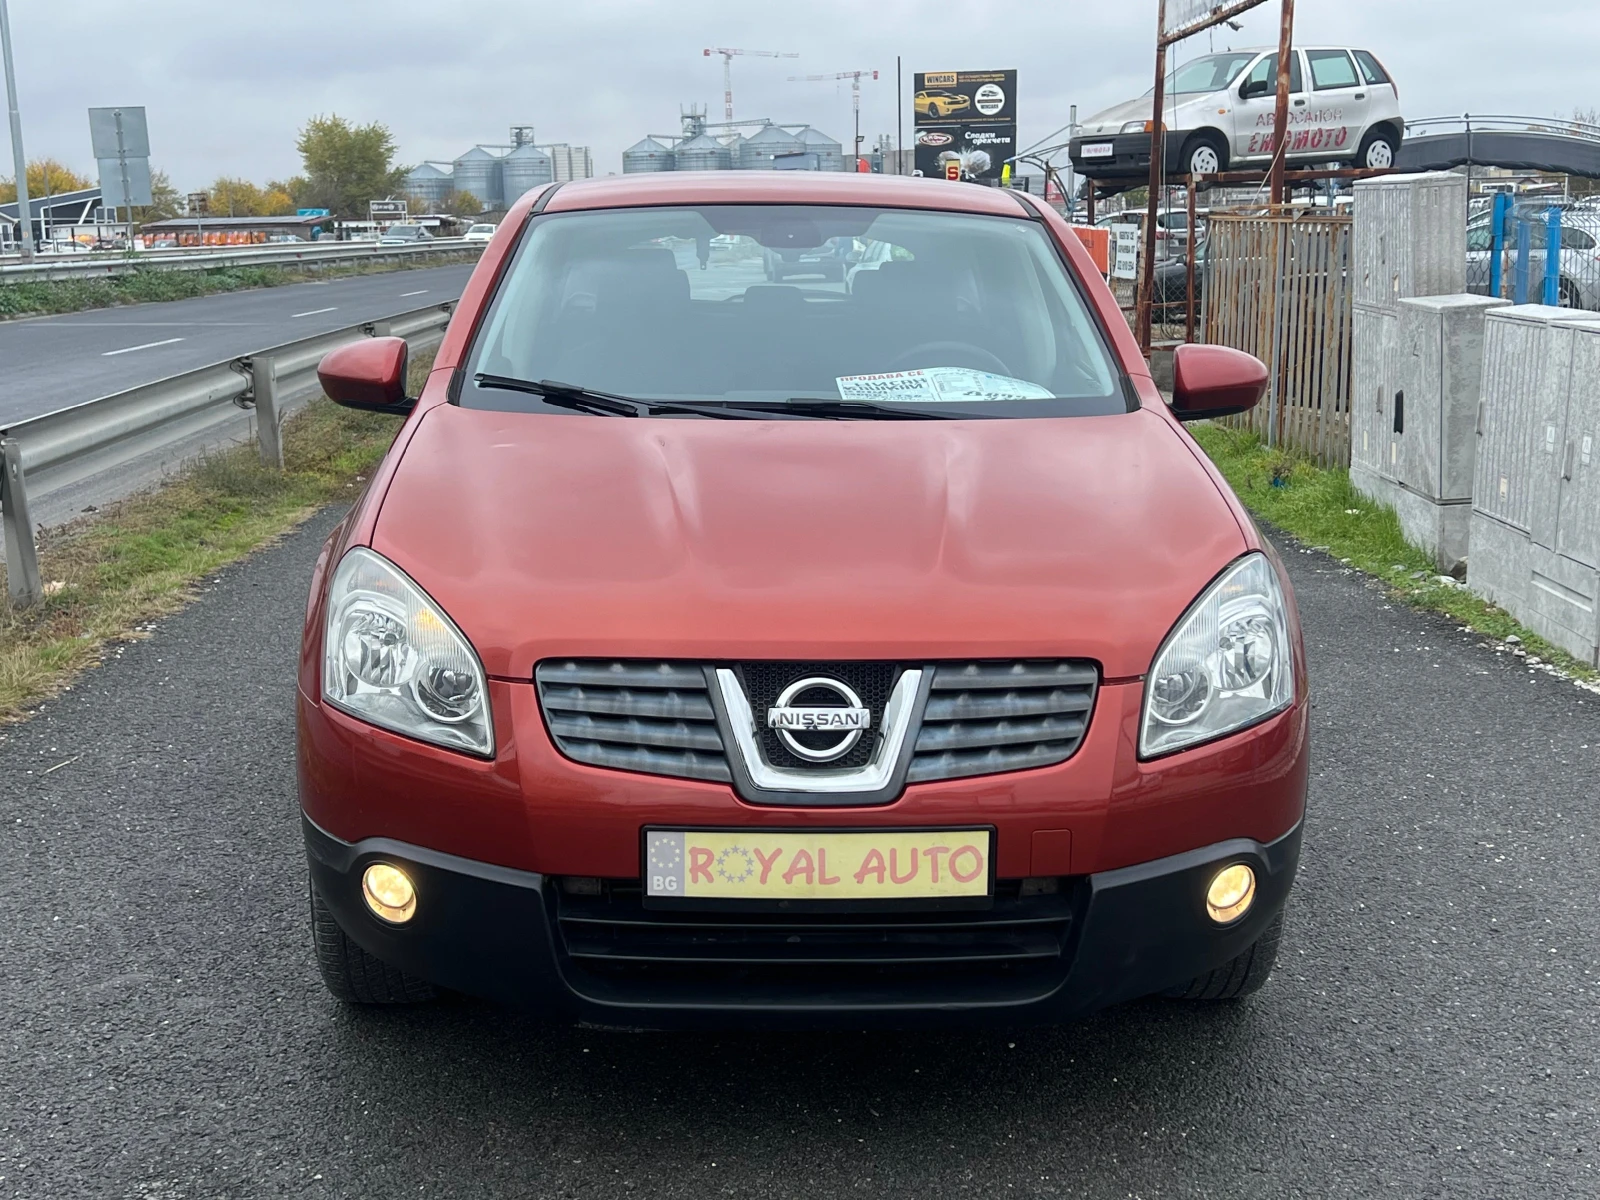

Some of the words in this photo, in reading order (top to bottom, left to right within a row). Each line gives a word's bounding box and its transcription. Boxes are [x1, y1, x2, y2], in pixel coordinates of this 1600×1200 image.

[926, 75, 955, 84] WINCARS
[1256, 109, 1342, 127] АВОСАЛОН
[964, 131, 996, 140] Сладки
[972, 137, 1011, 146] орехчета
[840, 372, 904, 382] ПРОДАВА
[779, 712, 860, 726] NISSAN
[688, 845, 841, 885] ROYAL
[853, 844, 984, 885] AUTO
[652, 875, 678, 891] BG
